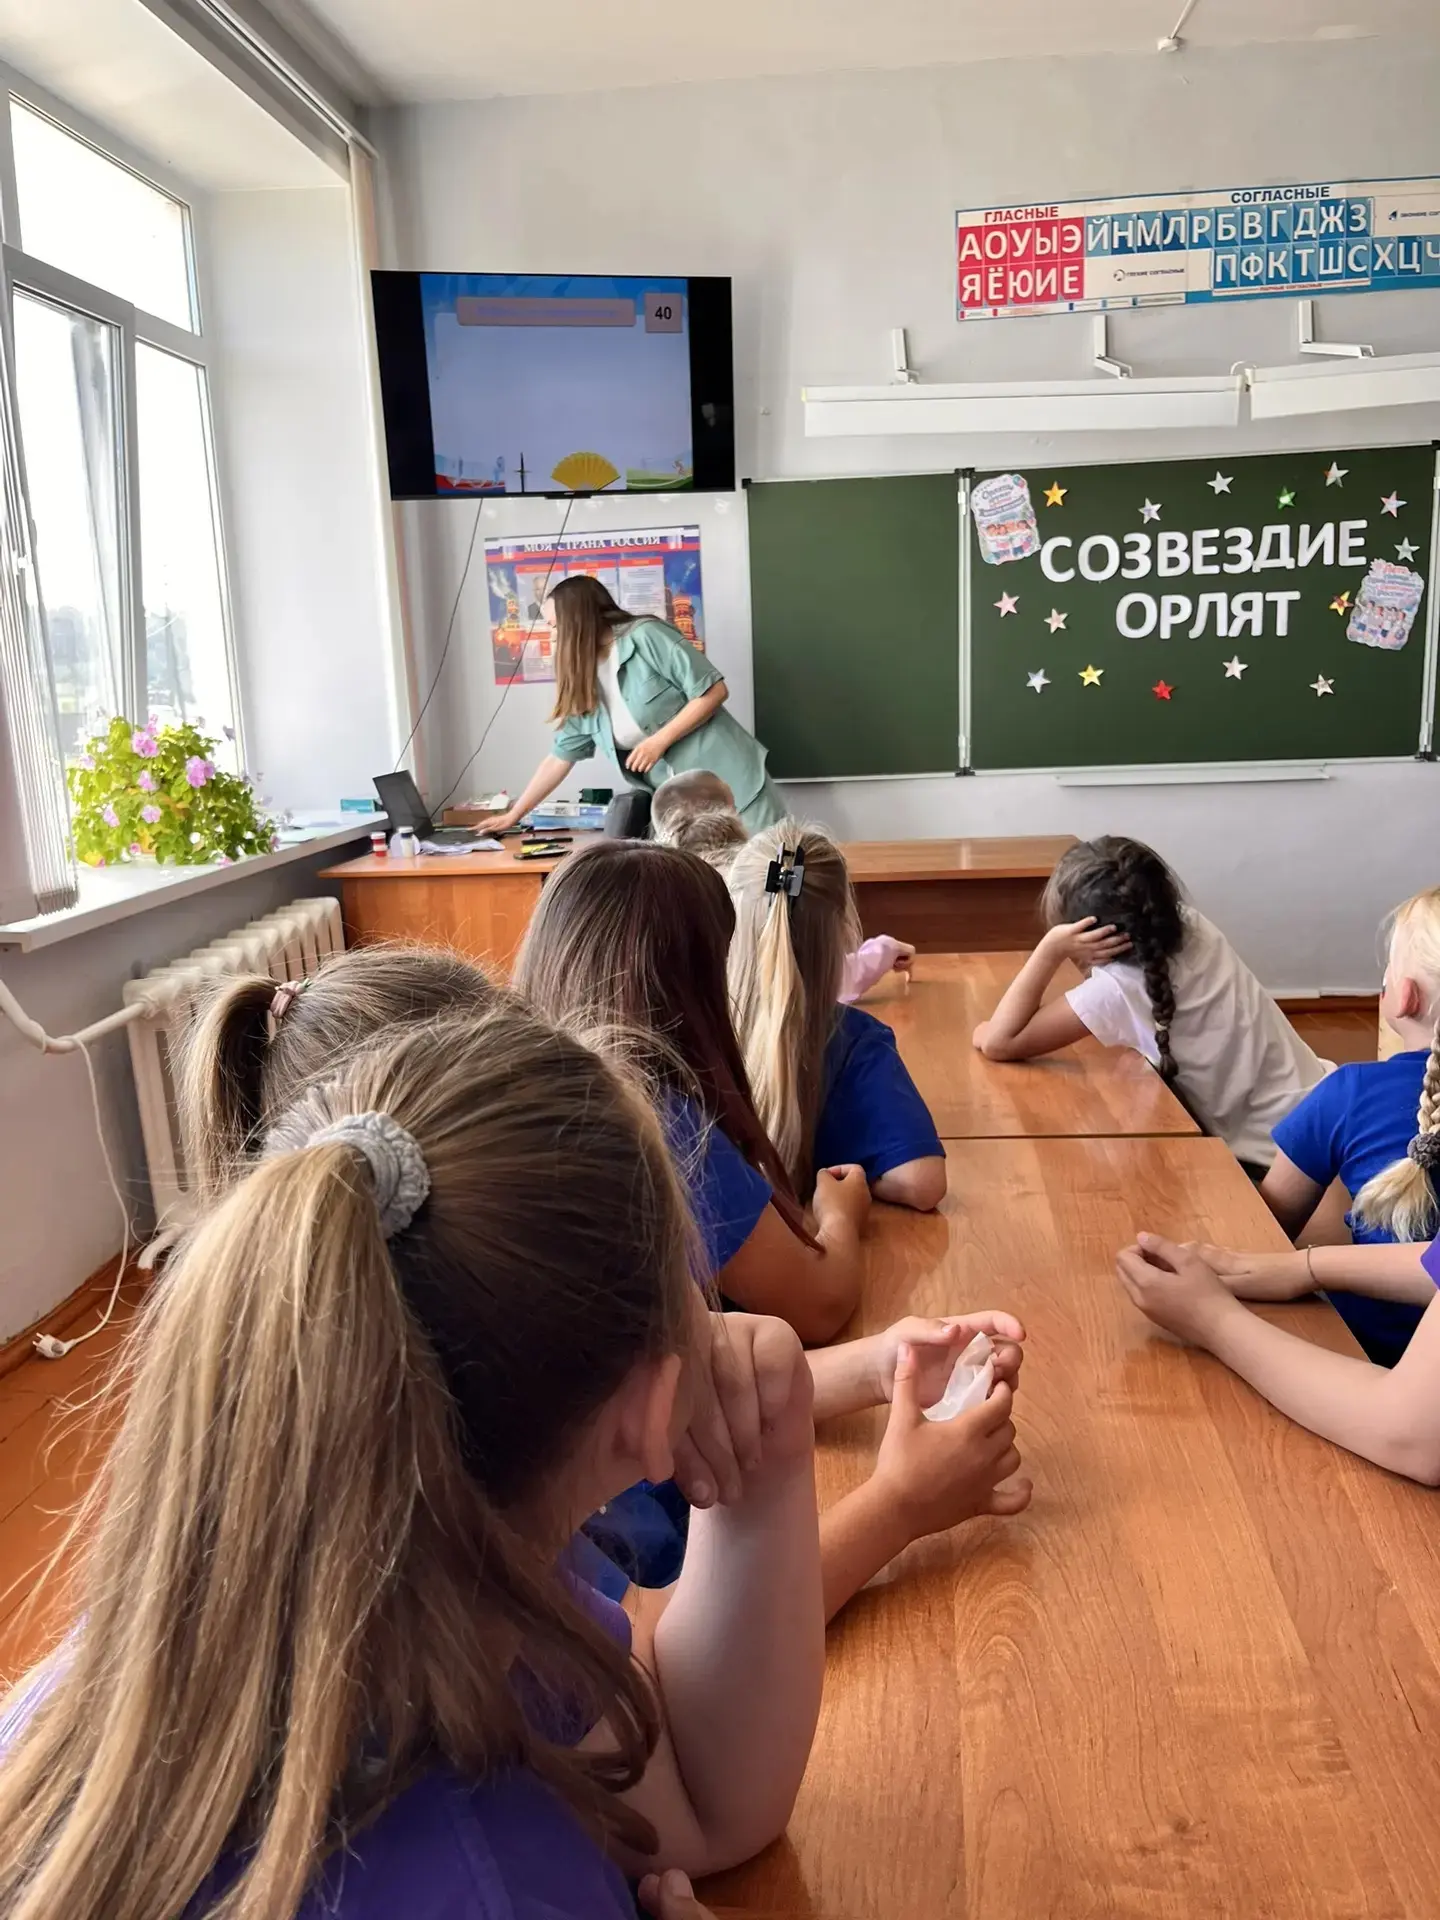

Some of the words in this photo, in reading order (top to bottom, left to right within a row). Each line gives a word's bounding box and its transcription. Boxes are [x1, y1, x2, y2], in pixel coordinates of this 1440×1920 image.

[1231, 186, 1329, 203] СОГЛАСНЫЕ
[984, 206, 1059, 223] ГЛАСНЫЕ
[654, 306, 672, 320] 40
[556, 539, 606, 551] СТРАНА
[610, 536, 661, 548] РОССИЯ
[1040, 518, 1368, 583] СОЗВЕЗДИЕ
[1115, 590, 1301, 640] ОРЛЯТ
